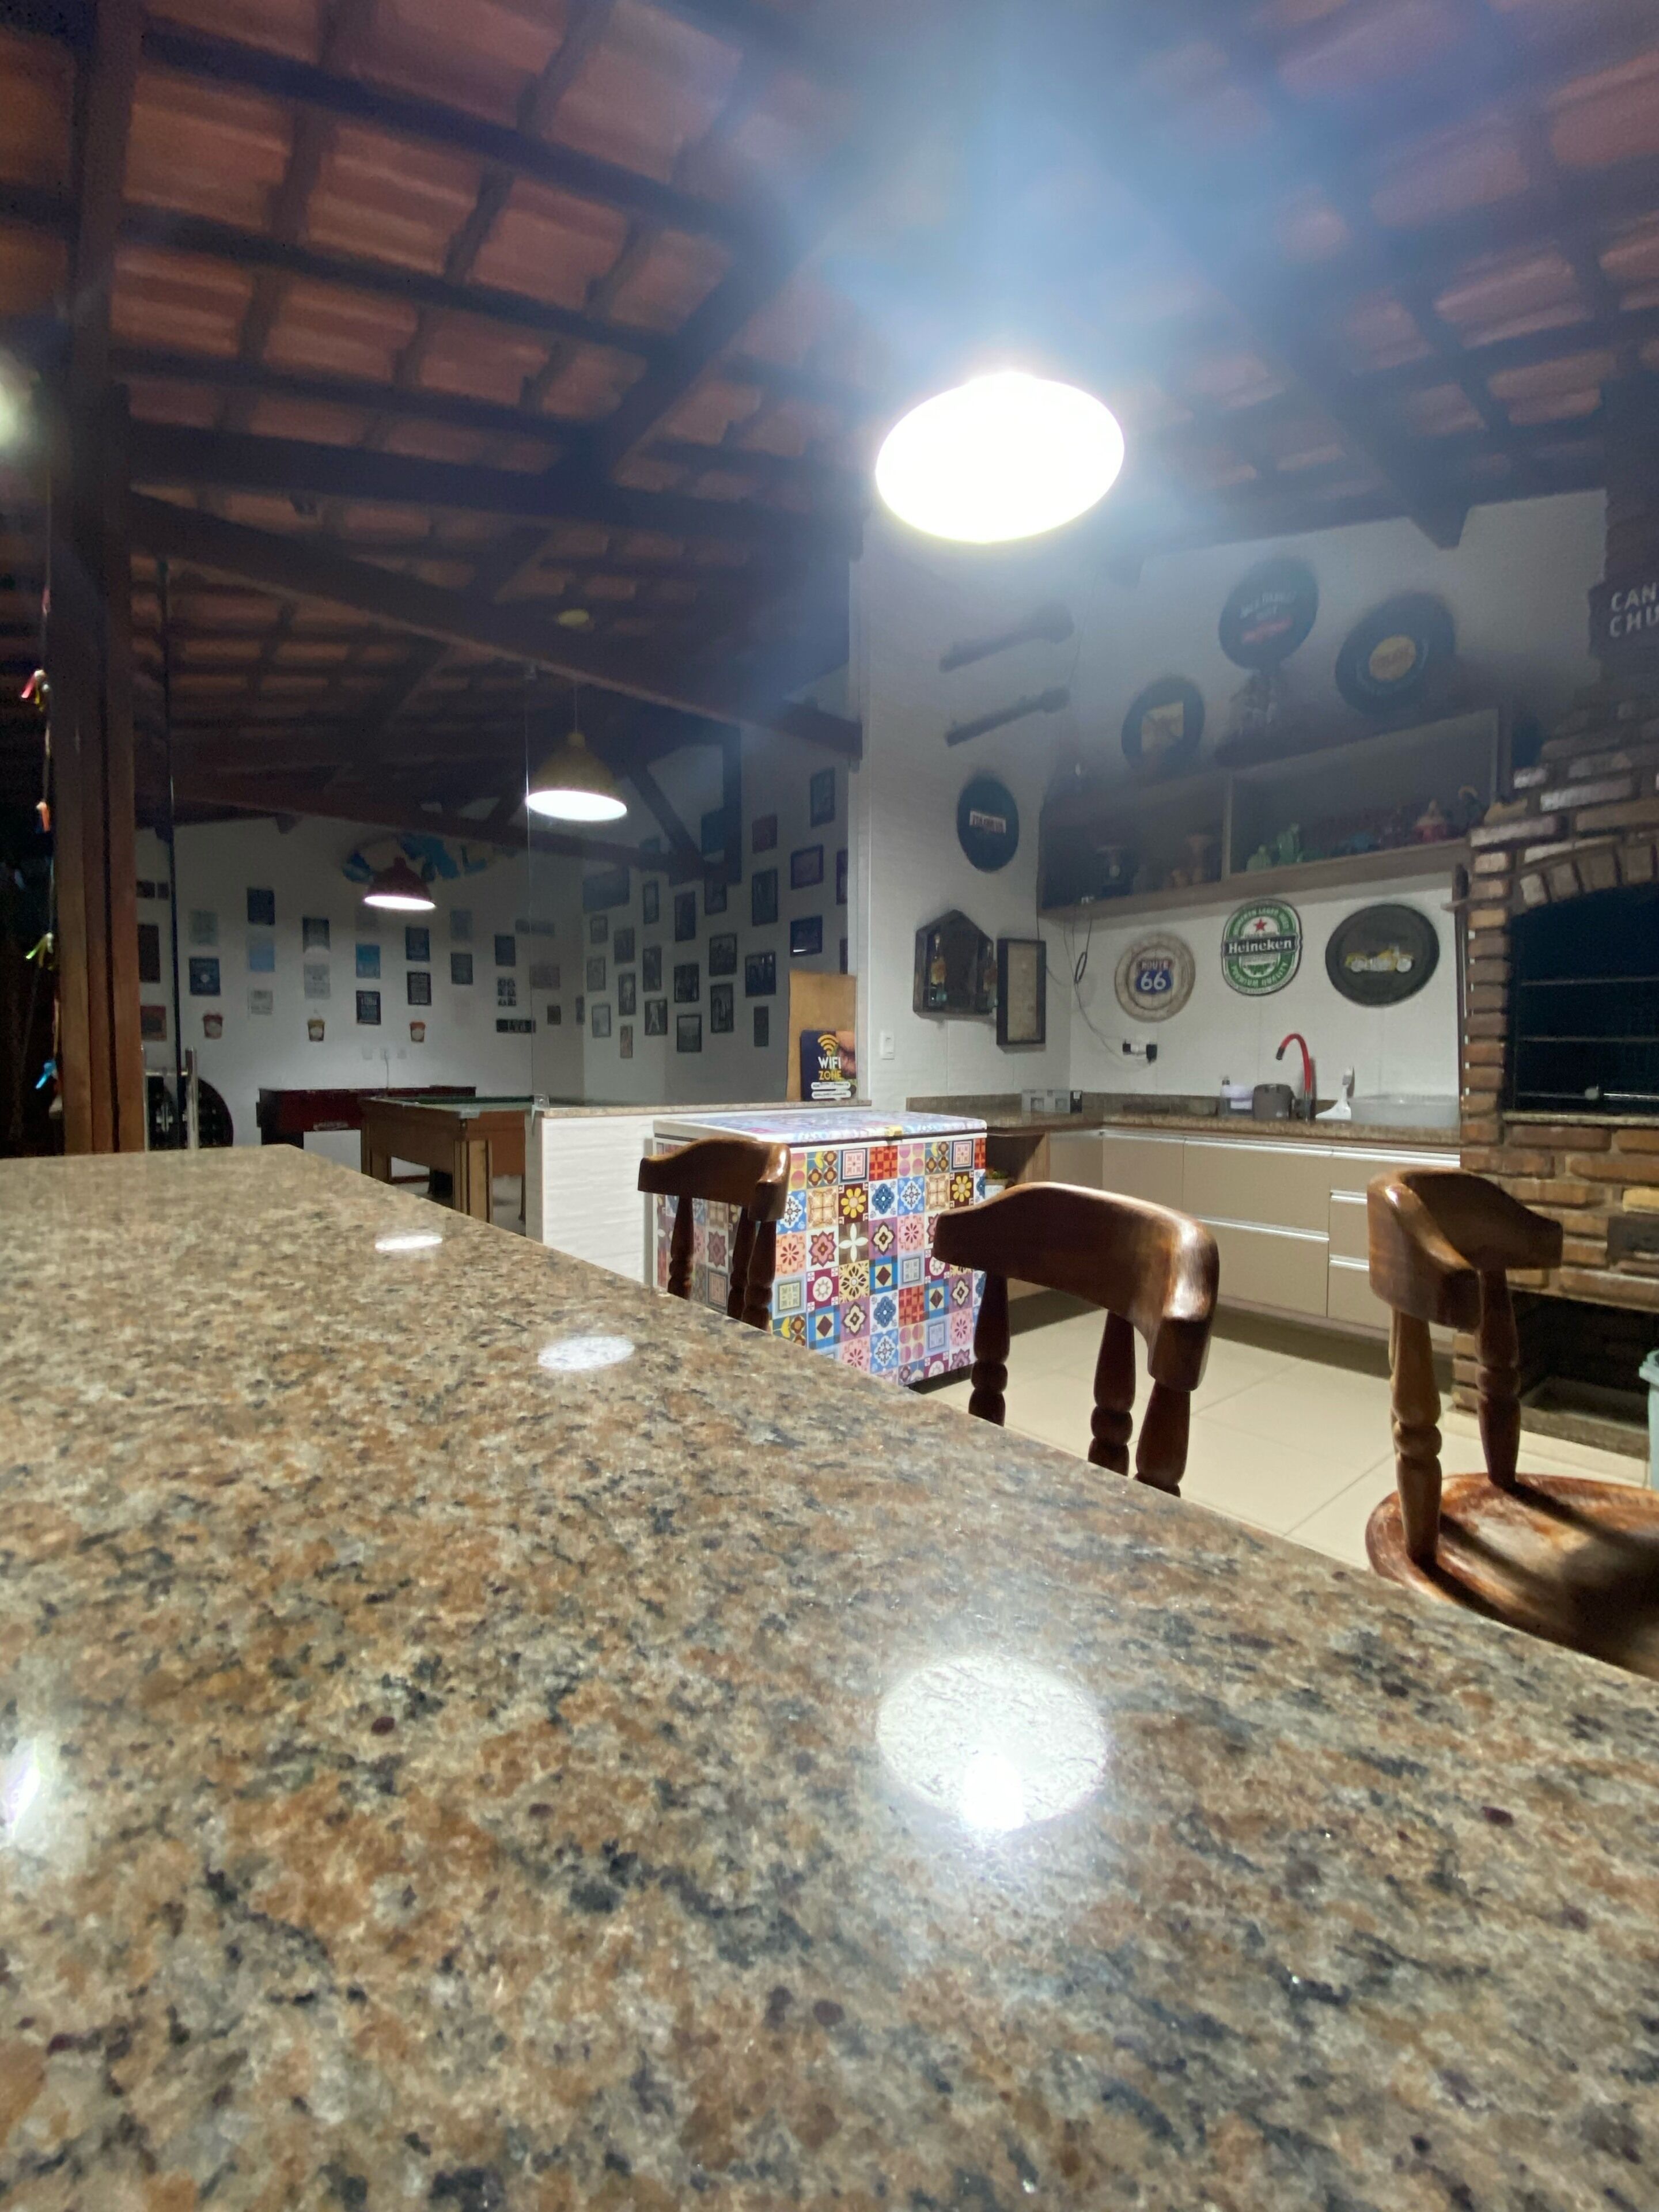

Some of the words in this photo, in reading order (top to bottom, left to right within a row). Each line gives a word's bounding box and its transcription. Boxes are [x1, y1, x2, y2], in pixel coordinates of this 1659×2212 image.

[1228, 939, 1292, 954] Heineken
[1141, 971, 1166, 990] 66
[817, 1056, 842, 1069] WIFI
[819, 1070, 842, 1081] ZONE
